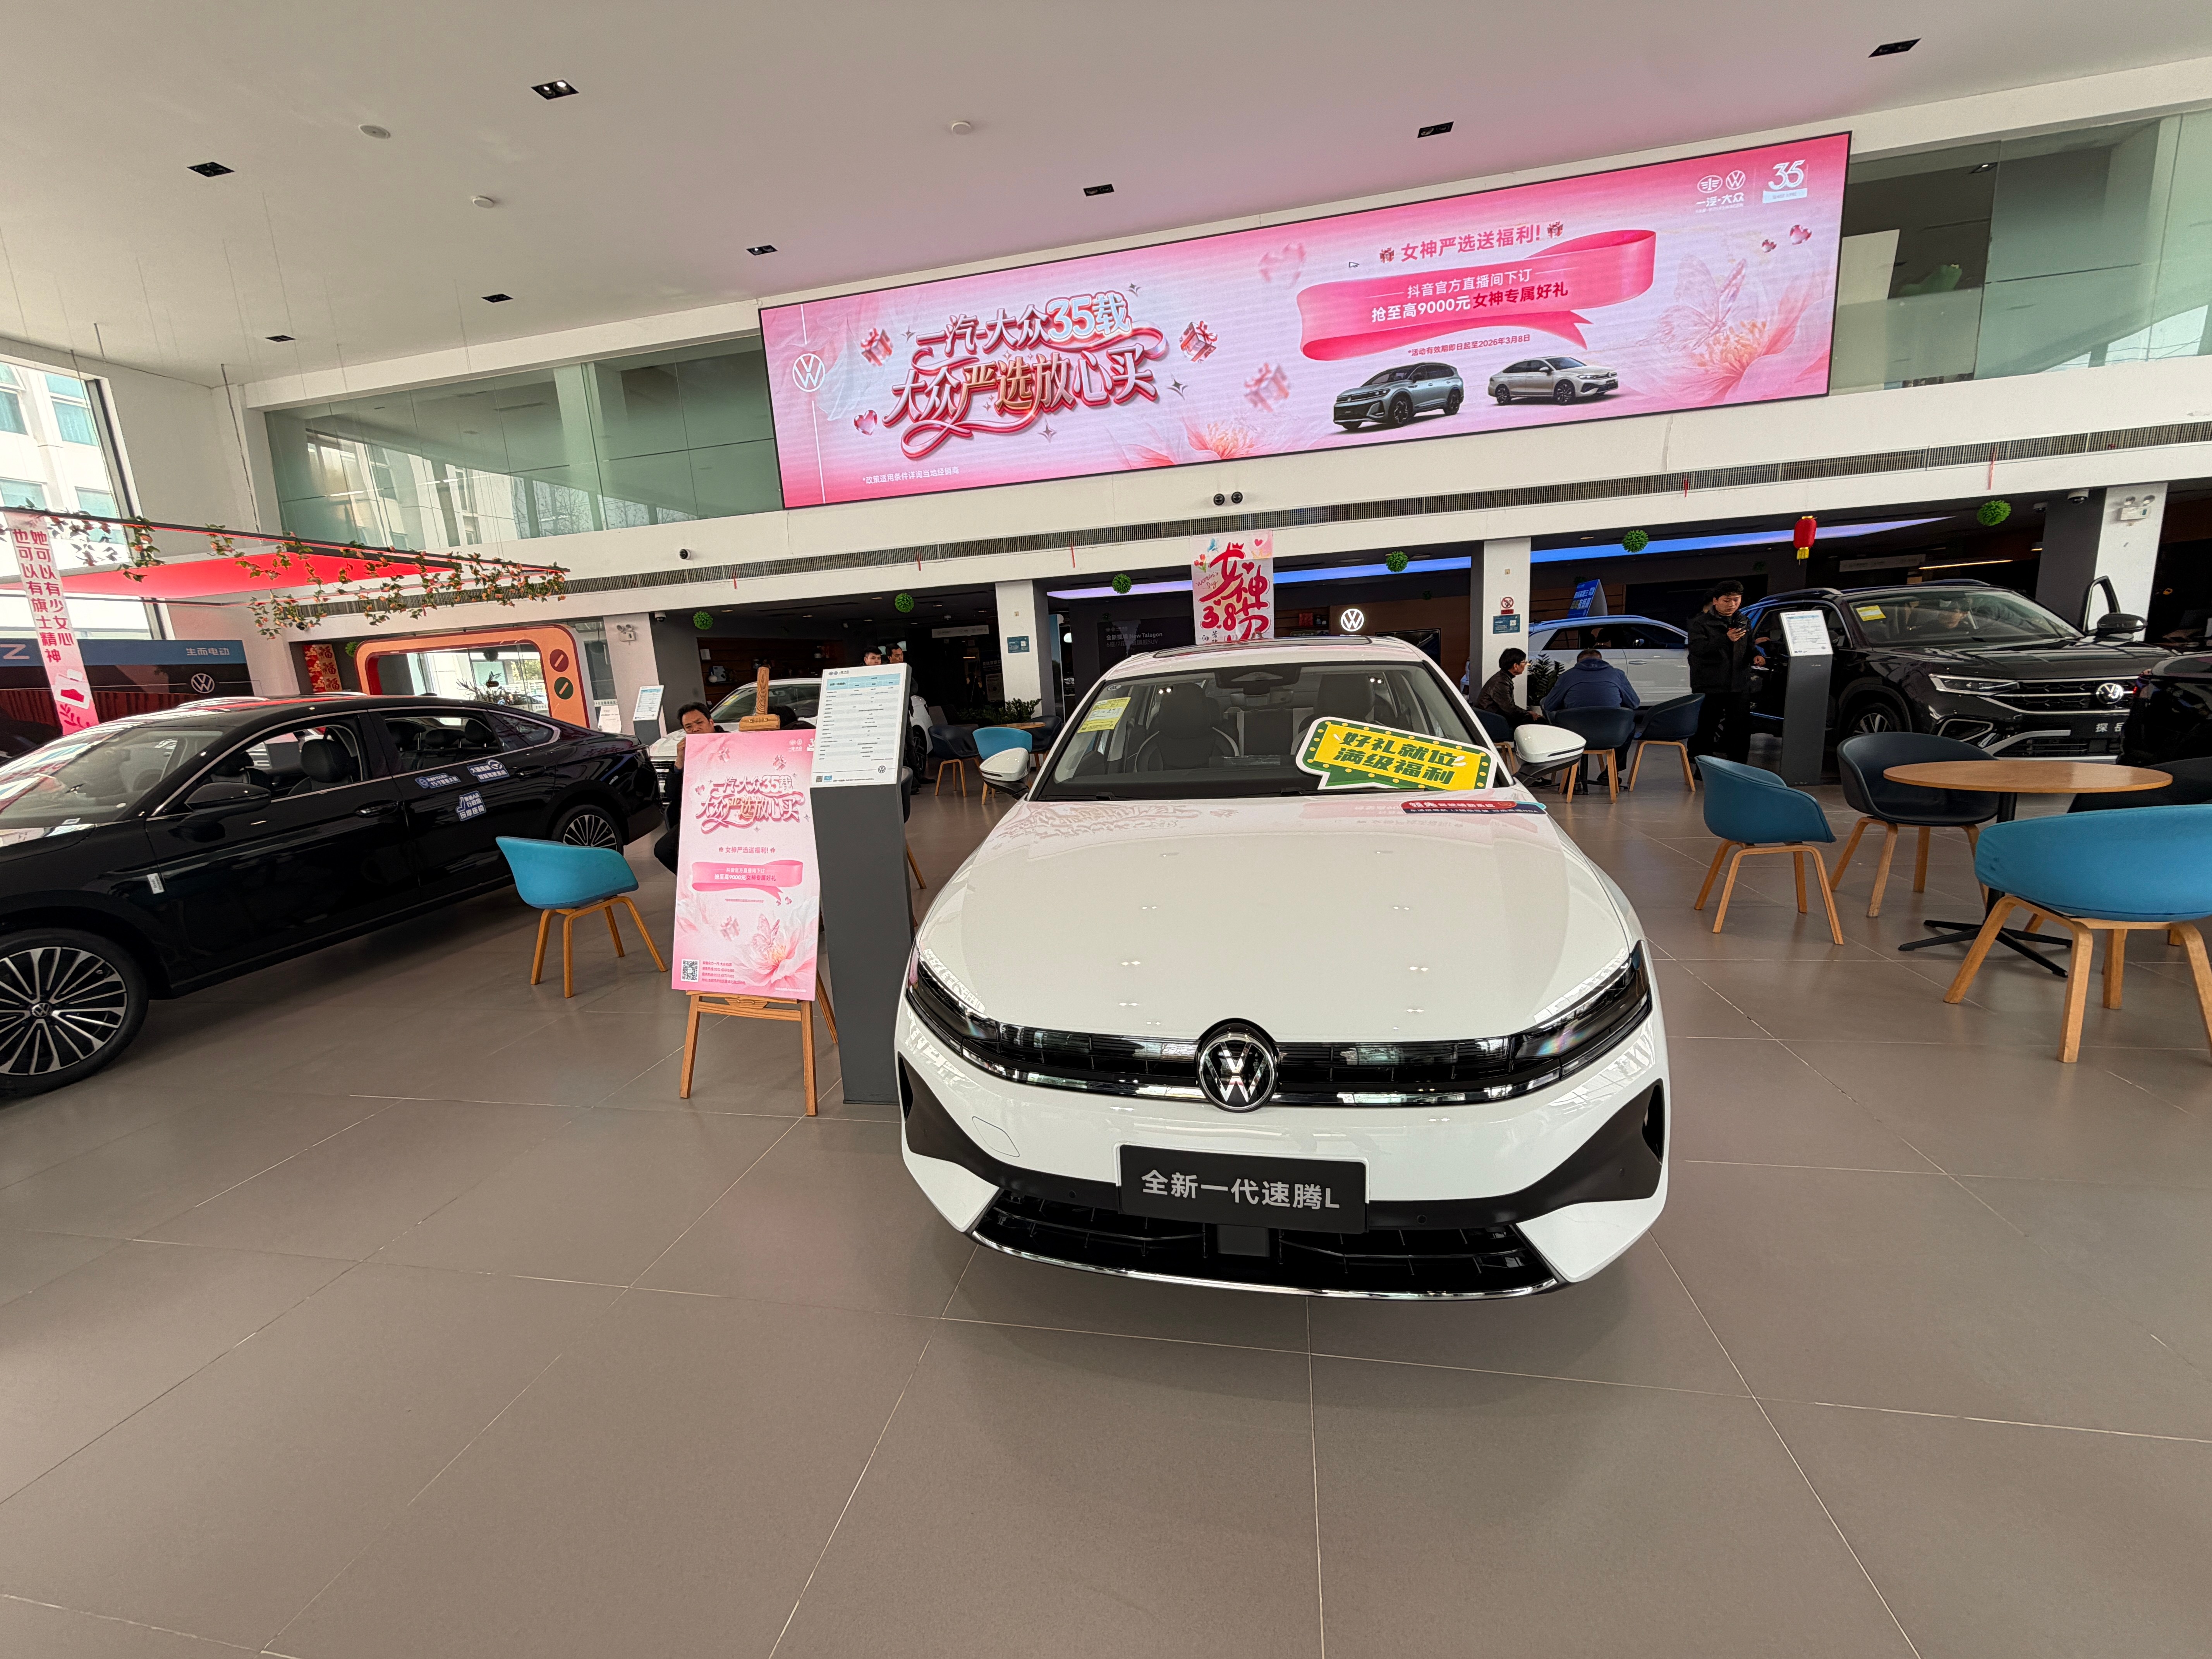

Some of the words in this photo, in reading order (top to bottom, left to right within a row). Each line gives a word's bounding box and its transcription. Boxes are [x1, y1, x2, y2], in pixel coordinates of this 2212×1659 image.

[1407, 268, 1532, 299] 抖音官方直播间下订
[882, 343, 1157, 428] 大众严选放心买
[31, 530, 74, 646] 她可以有少女心
[1206, 580, 1219, 589] Day
[186, 647, 230, 656] 生而电动
[1333, 747, 1455, 785] 满级福利
[1339, 732, 1456, 767] 好礼就位
[696, 795, 800, 822] 大众严选放心买
[1141, 1169, 1341, 1210] 全新一代速腾L
